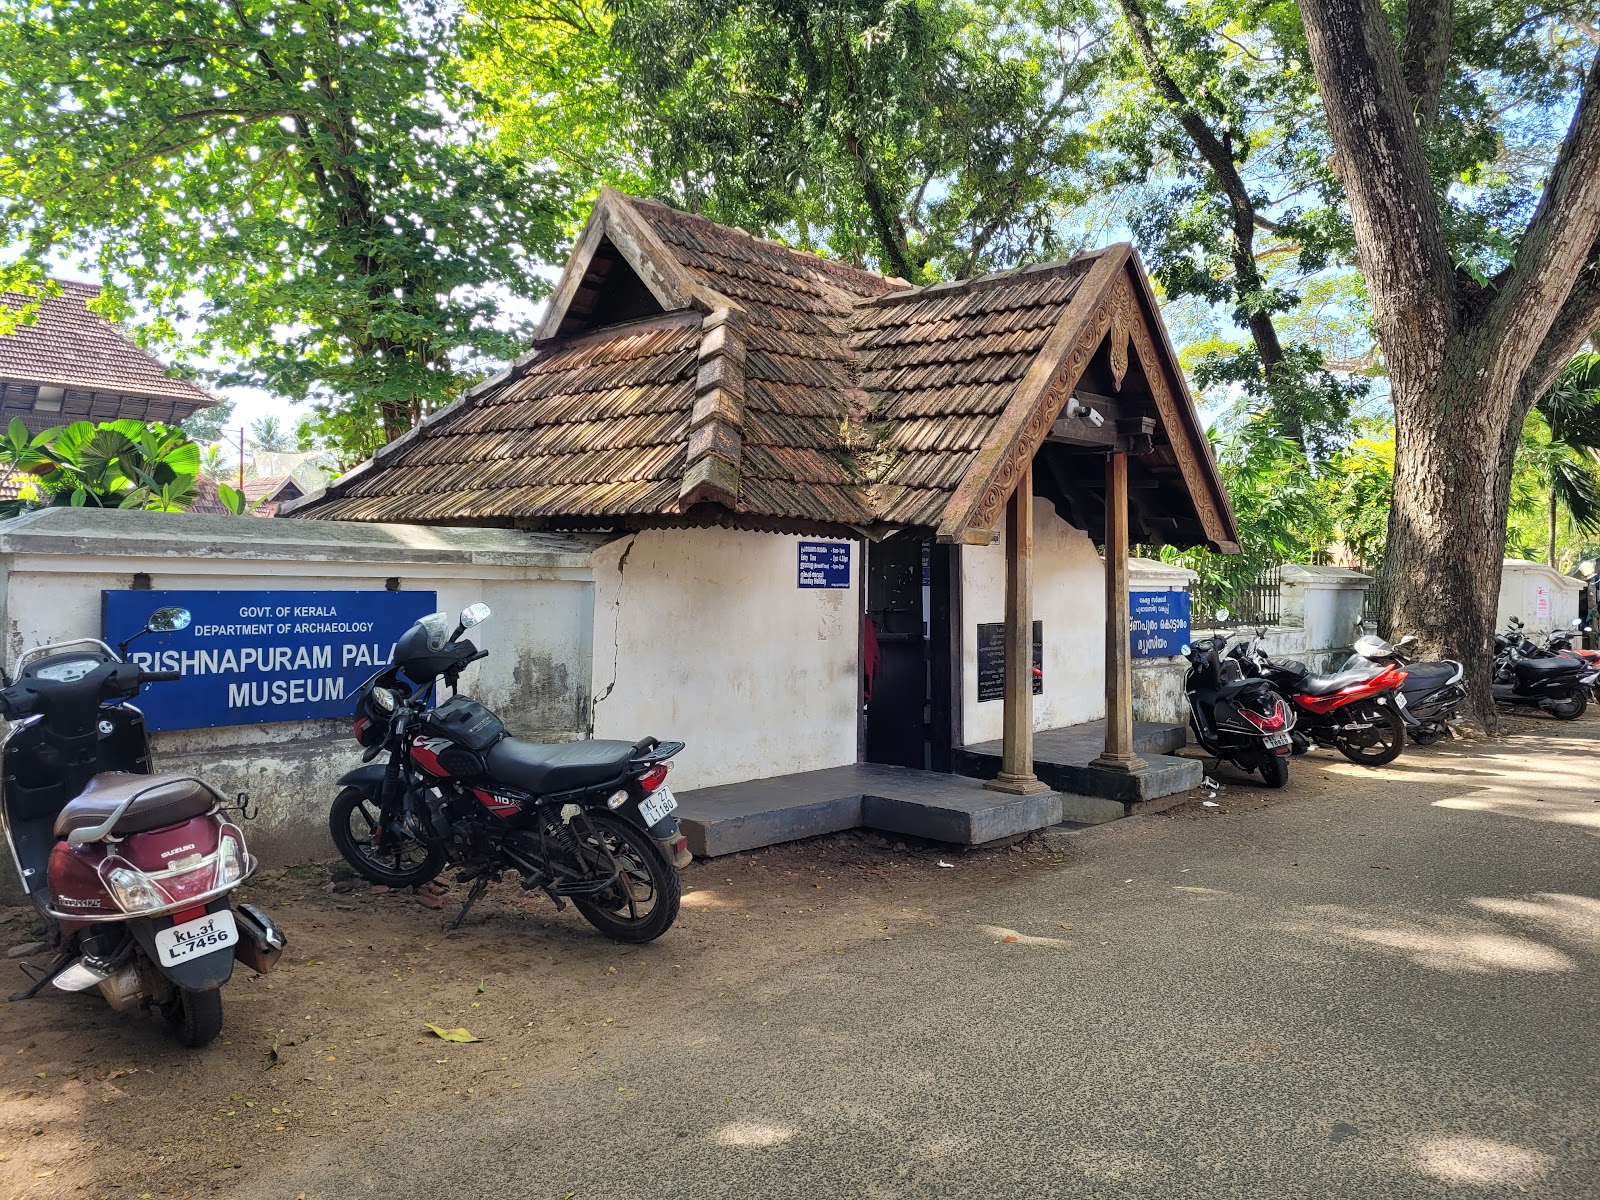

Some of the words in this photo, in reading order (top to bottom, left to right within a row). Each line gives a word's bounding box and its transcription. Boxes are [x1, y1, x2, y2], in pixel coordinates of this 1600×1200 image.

[800, 577, 813, 585] Monday
[814, 577, 827, 586] Holiday
[239, 607, 273, 618] GOVT.
[275, 607, 291, 617] OF
[293, 606, 337, 617] KERALA
[194, 624, 273, 637] DEPARTMENT
[276, 624, 292, 635] OF
[293, 622, 374, 634] ARCHAEOLOGY
[127, 645, 332, 676] RISHNAPURAM
[228, 677, 344, 708] MUSEUM
[644, 799, 657, 811] KL
[657, 788, 668, 802] 27
[649, 799, 674, 822] L1180
[160, 843, 196, 859] SUZUKI
[174, 922, 215, 943] KL.31
[168, 930, 229, 959] L.7456
